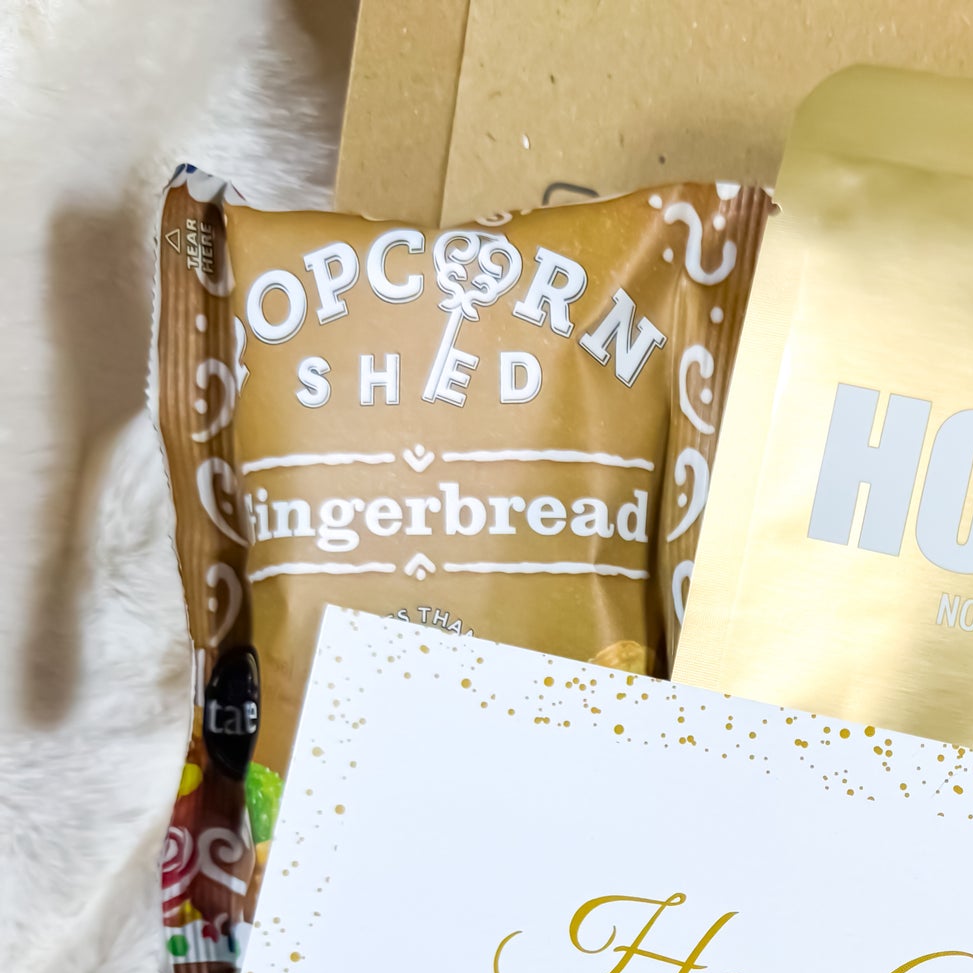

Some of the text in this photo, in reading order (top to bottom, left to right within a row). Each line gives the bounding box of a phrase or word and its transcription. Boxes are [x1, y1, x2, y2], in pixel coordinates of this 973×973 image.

[186, 218, 200, 270] TEAR
[200, 221, 214, 274] HERE
[234, 228, 668, 396] OPCORN
[296, 350, 544, 408] SHED
[245, 481, 650, 553] ingerbread
